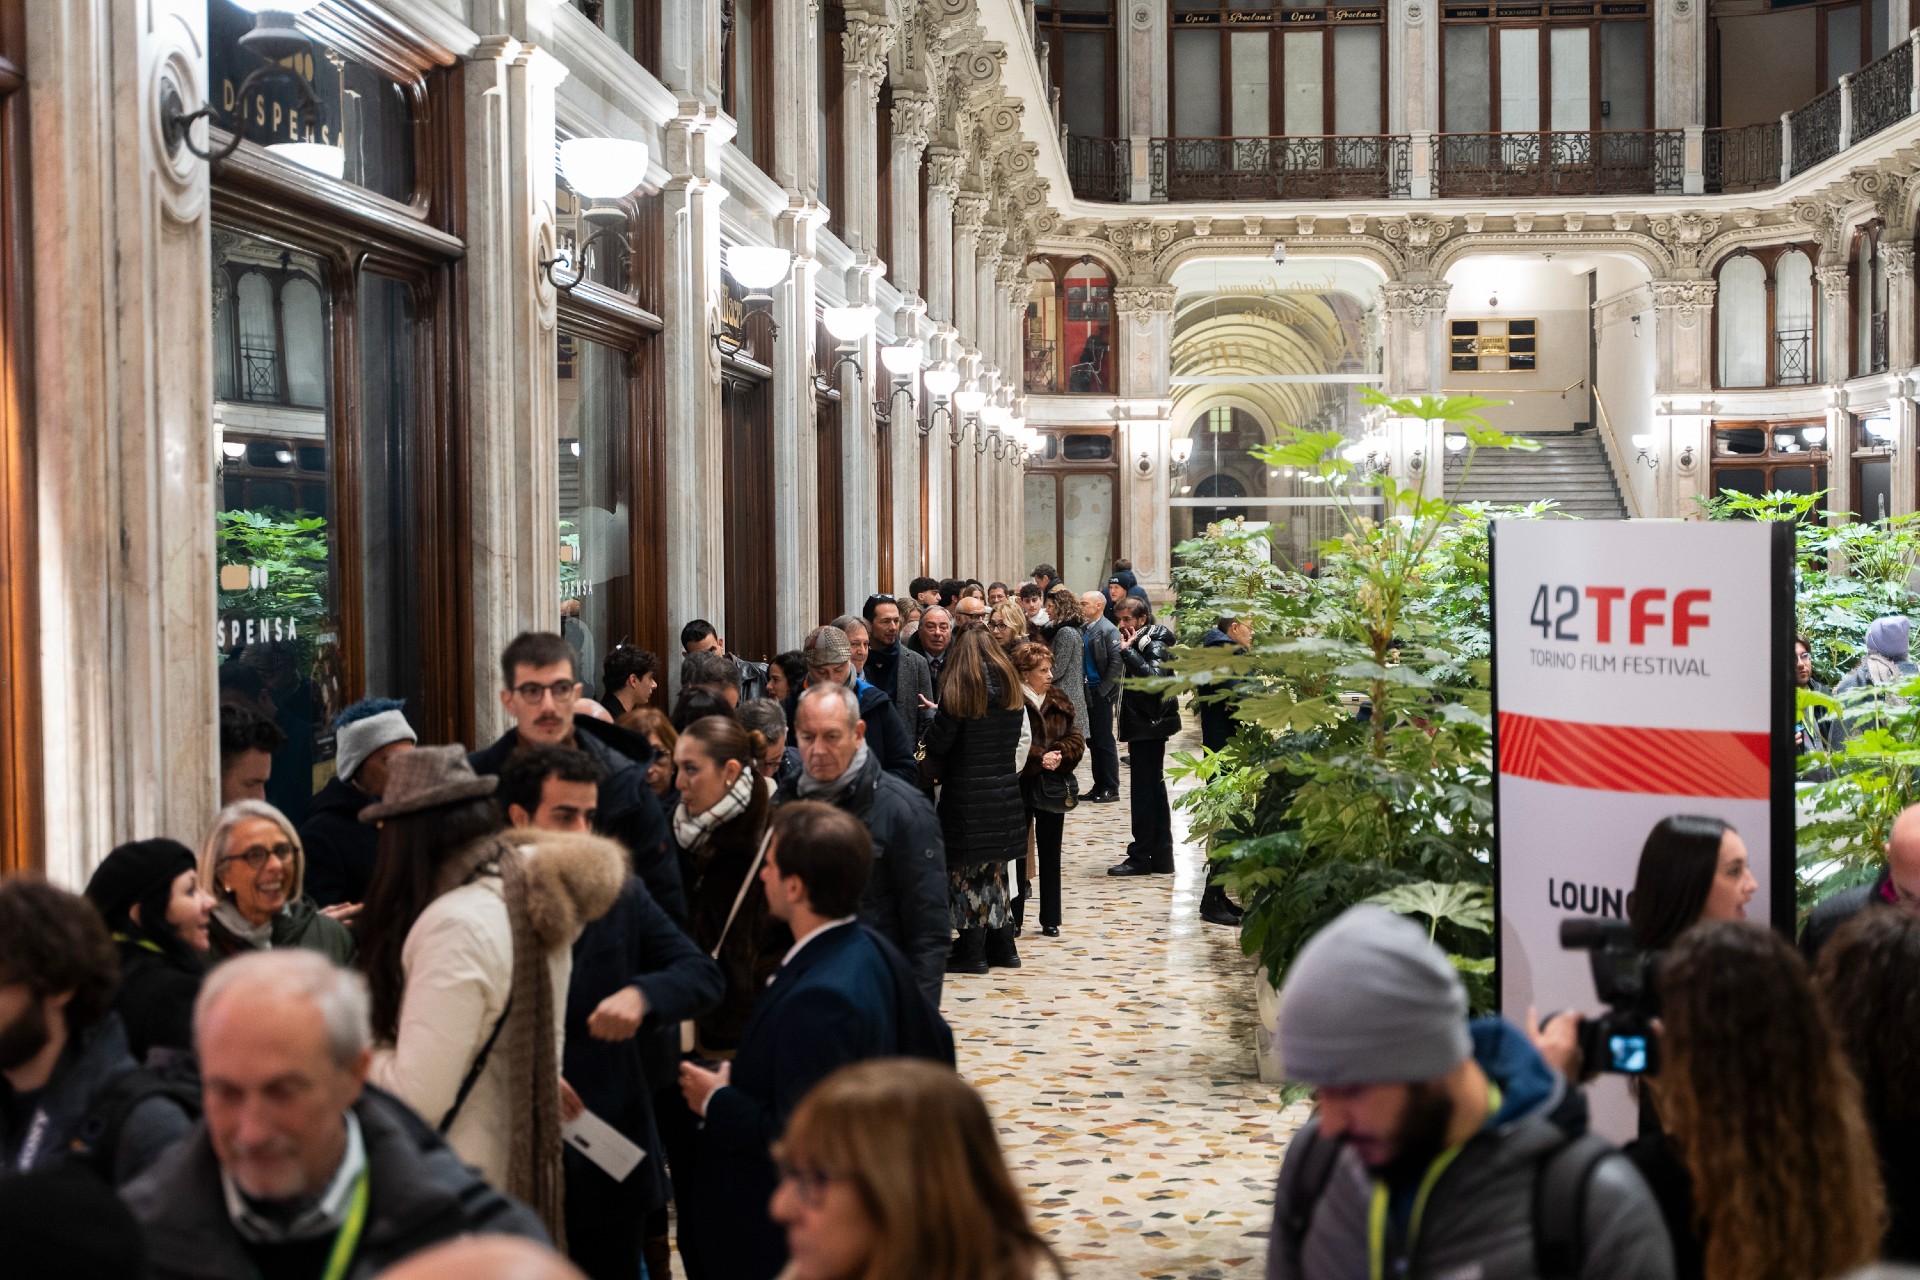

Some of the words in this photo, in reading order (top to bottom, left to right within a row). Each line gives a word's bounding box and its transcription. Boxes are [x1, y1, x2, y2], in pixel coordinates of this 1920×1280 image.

[217, 616, 297, 647] SPENSA
[1530, 648, 1576, 670] TORINO
[1581, 654, 1616, 673] FILM
[1623, 656, 1711, 677] FESTIVAL
[1549, 877, 1634, 919] LOUN
